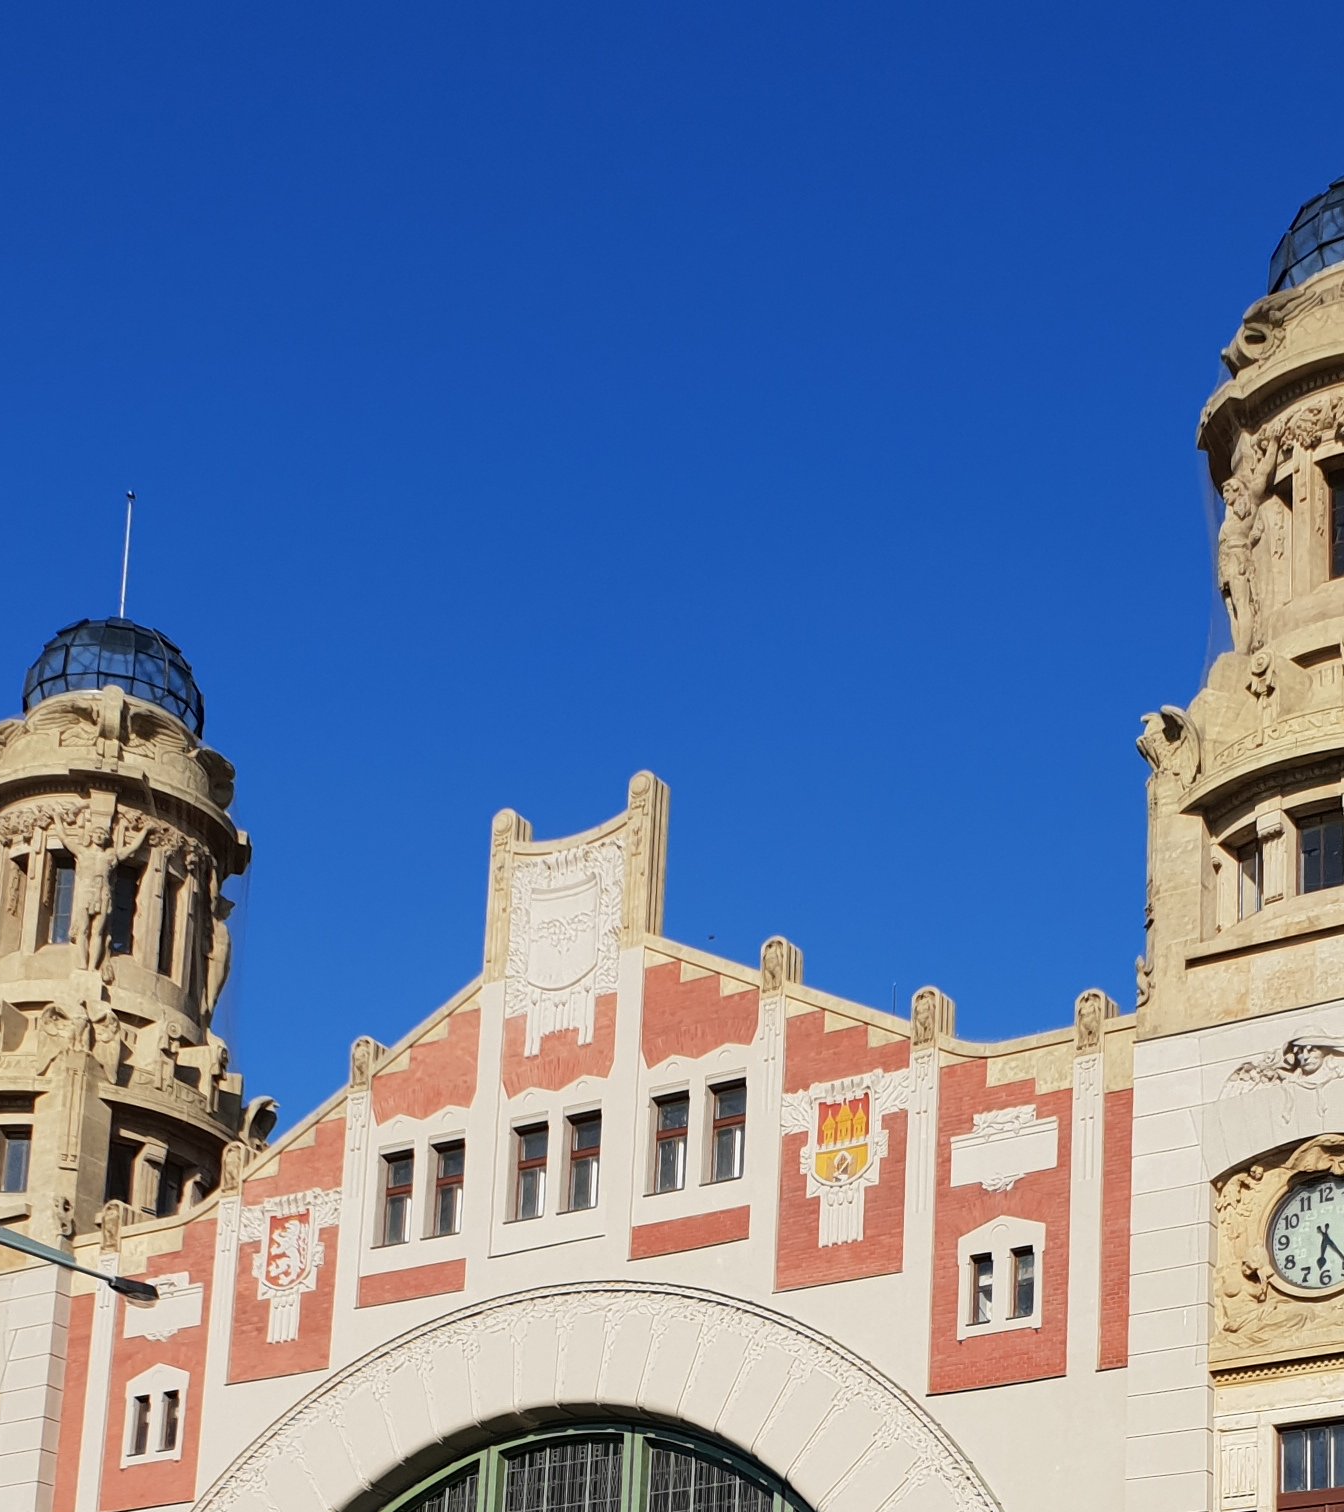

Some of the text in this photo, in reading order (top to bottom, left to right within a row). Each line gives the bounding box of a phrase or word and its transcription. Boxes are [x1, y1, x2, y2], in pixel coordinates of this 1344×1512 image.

[1318, 1186, 1334, 1203] 12
[1299, 1195, 1312, 1212] 11
[1282, 1213, 1300, 1230] 10
[1277, 1234, 1290, 1251] 9
[1284, 1254, 1296, 1270] 8
[1300, 1266, 1311, 1283] 7
[1319, 1269, 1332, 1285] 6
